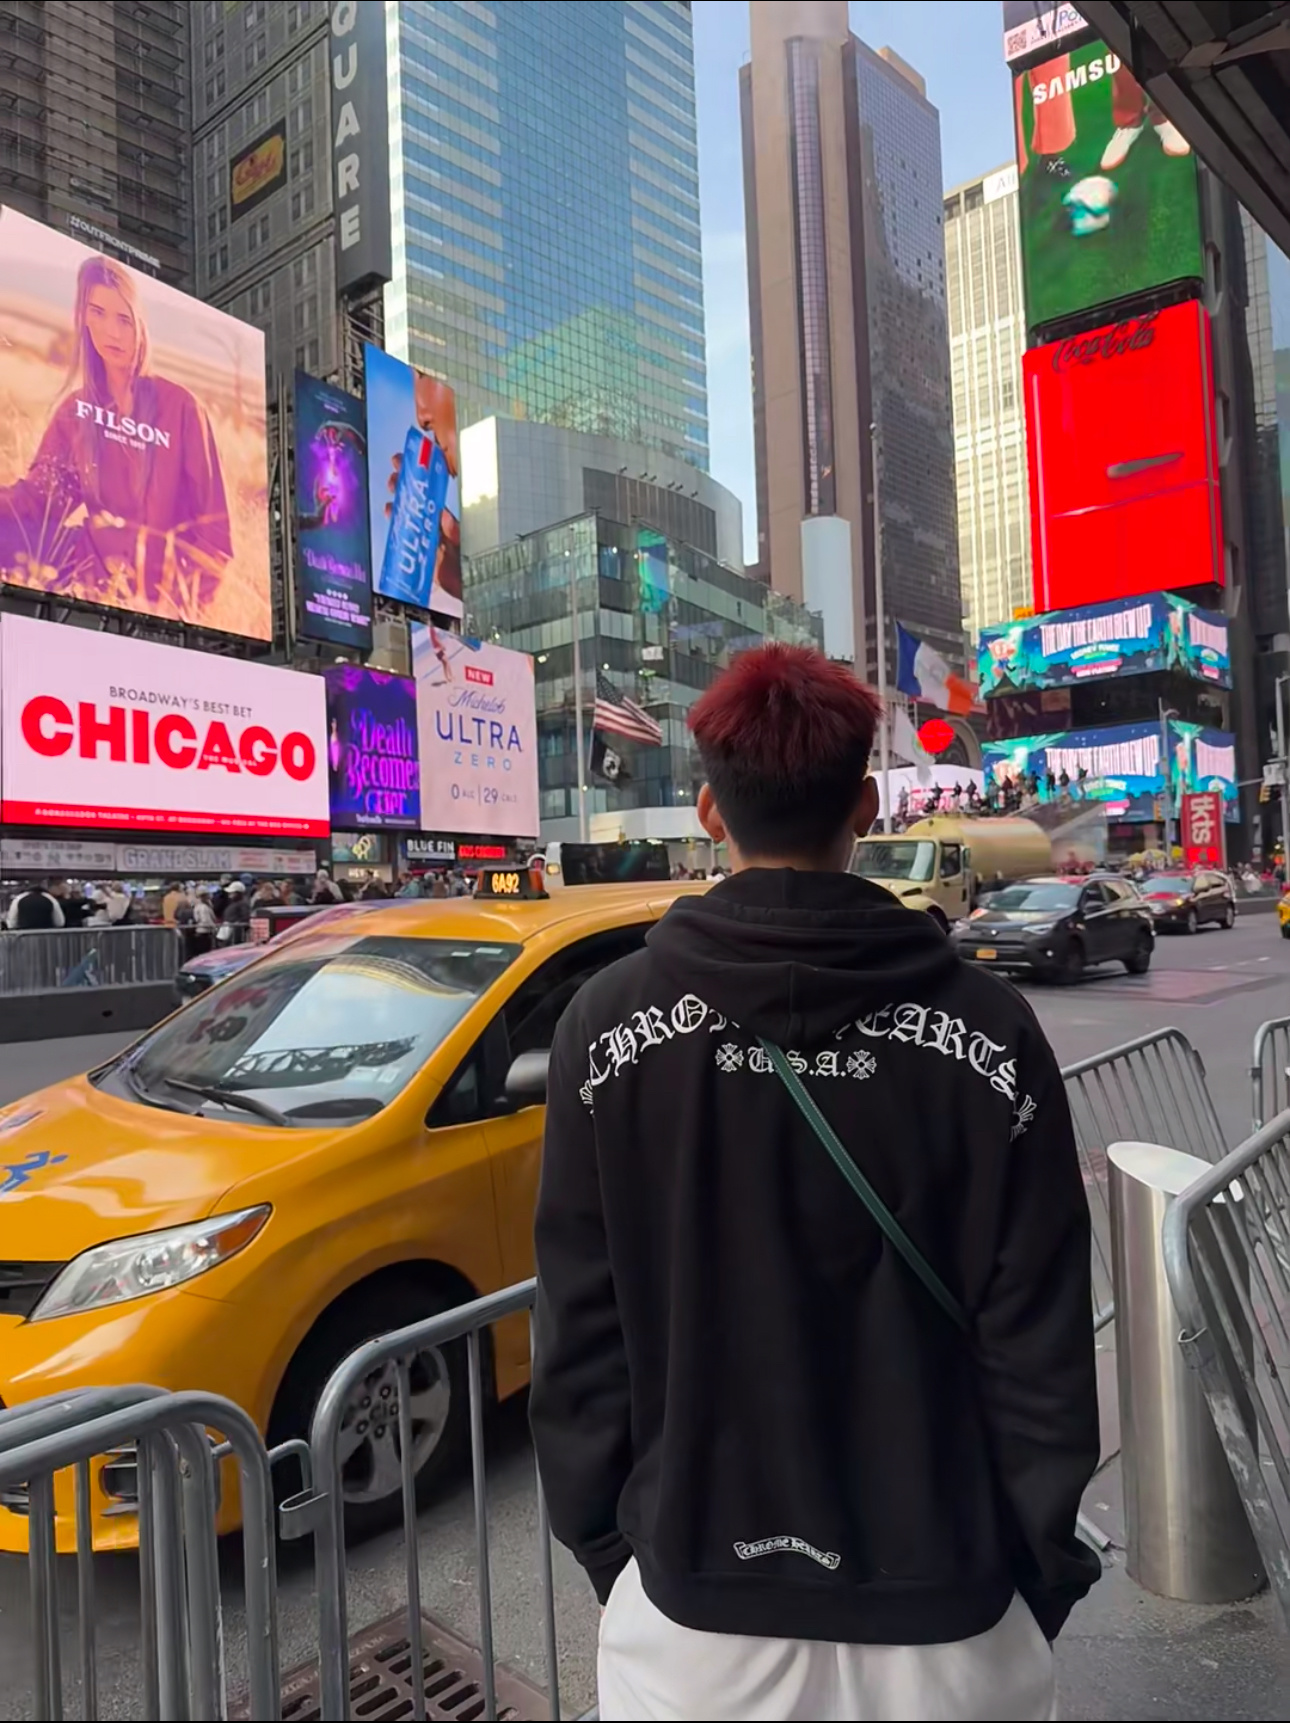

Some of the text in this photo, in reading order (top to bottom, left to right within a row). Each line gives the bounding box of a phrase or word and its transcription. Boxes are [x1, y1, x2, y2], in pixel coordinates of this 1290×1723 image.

[75, 399, 170, 449] FILSON
[398, 478, 429, 575] ULTRA
[467, 668, 491, 684] NEW
[109, 686, 252, 718] BROADWAY'S BEST BET
[448, 687, 506, 715] Michelob
[21, 695, 316, 781] CHICAGO
[436, 710, 523, 753] ULTRA
[454, 751, 512, 771] ZERO
[451, 783, 460, 800] 0
[483, 787, 499, 804] 29
[1190, 795, 1215, 845] tkts
[407, 839, 434, 852] BLUE
[437, 841, 455, 853] FIN
[491, 873, 520, 894] 6A92
